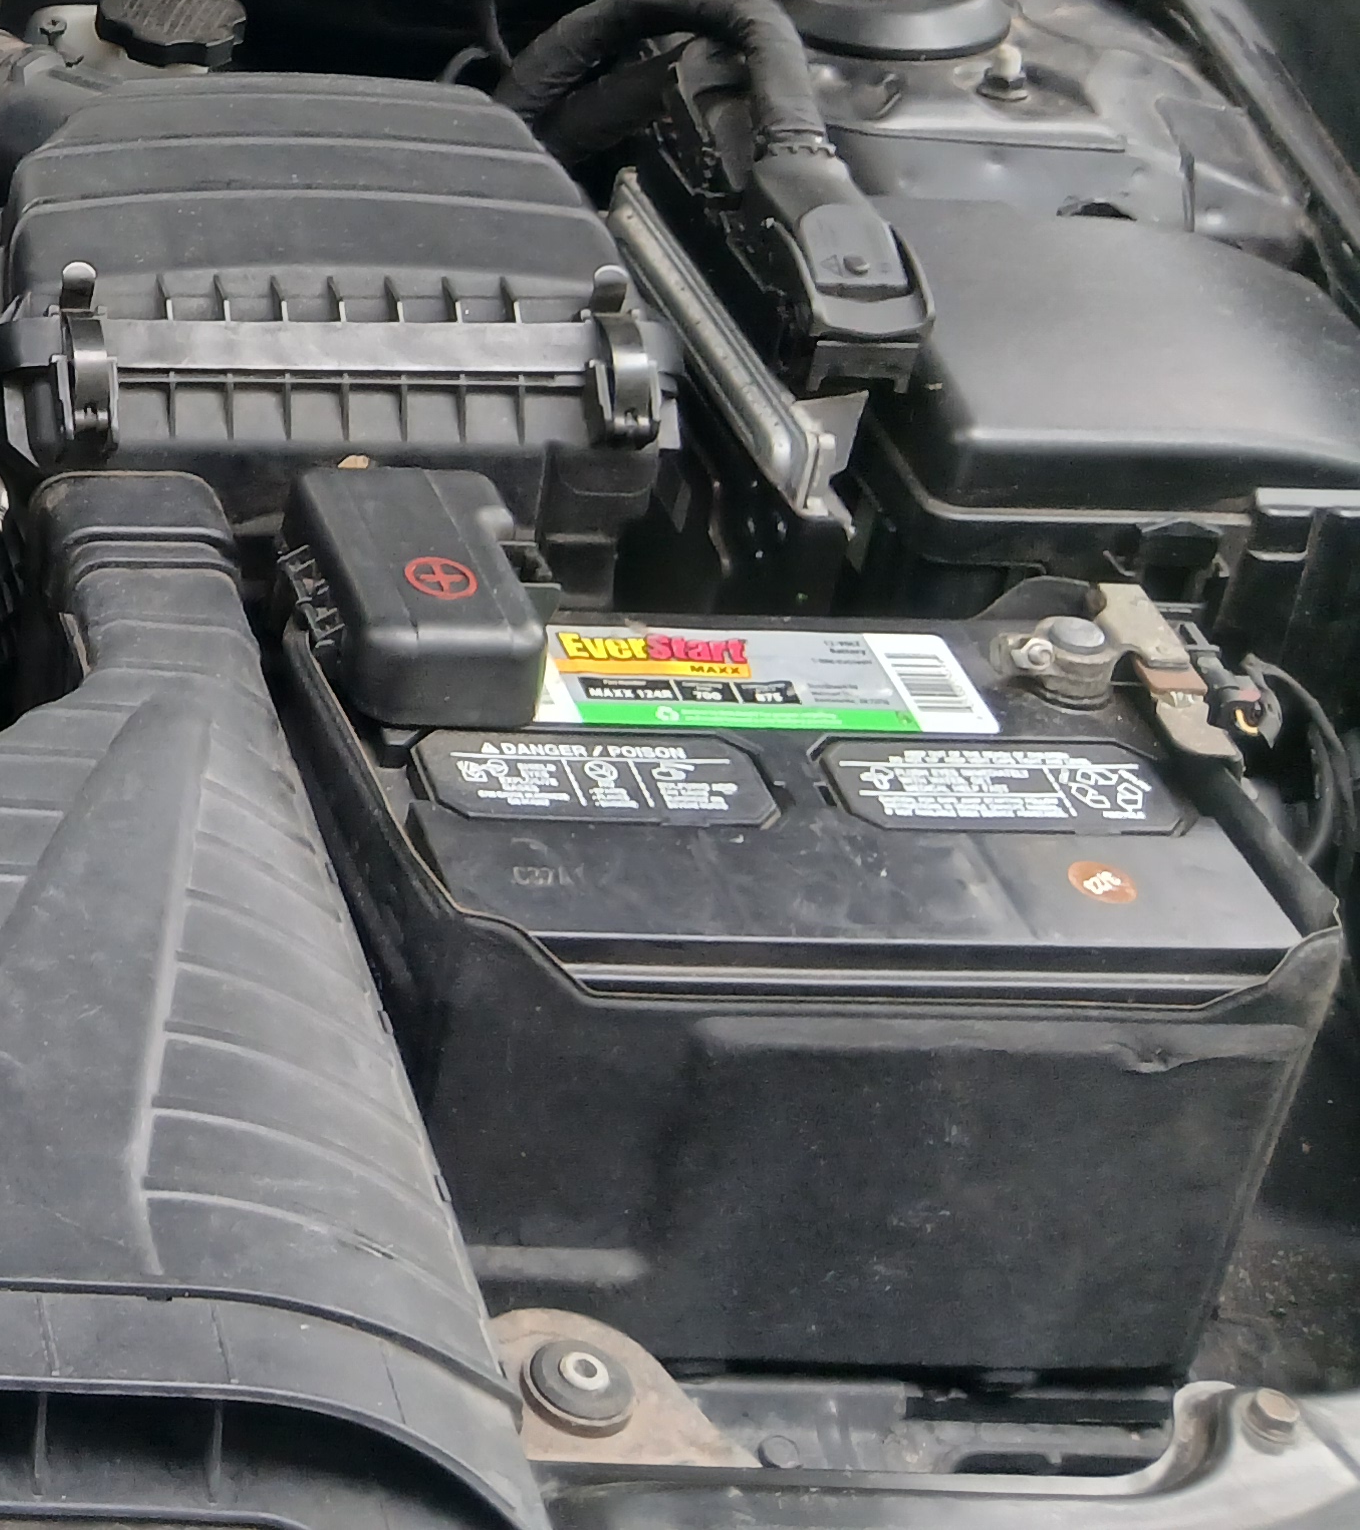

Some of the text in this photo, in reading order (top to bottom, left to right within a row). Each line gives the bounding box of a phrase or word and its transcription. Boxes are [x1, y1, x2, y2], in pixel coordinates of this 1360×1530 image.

[555, 631, 749, 664] EverStart
[689, 664, 742, 675] MAXX
[588, 686, 674, 700] MAXX 124R
[693, 690, 723, 701] 700
[500, 742, 588, 758] DANGER
[607, 745, 687, 760] POISON
